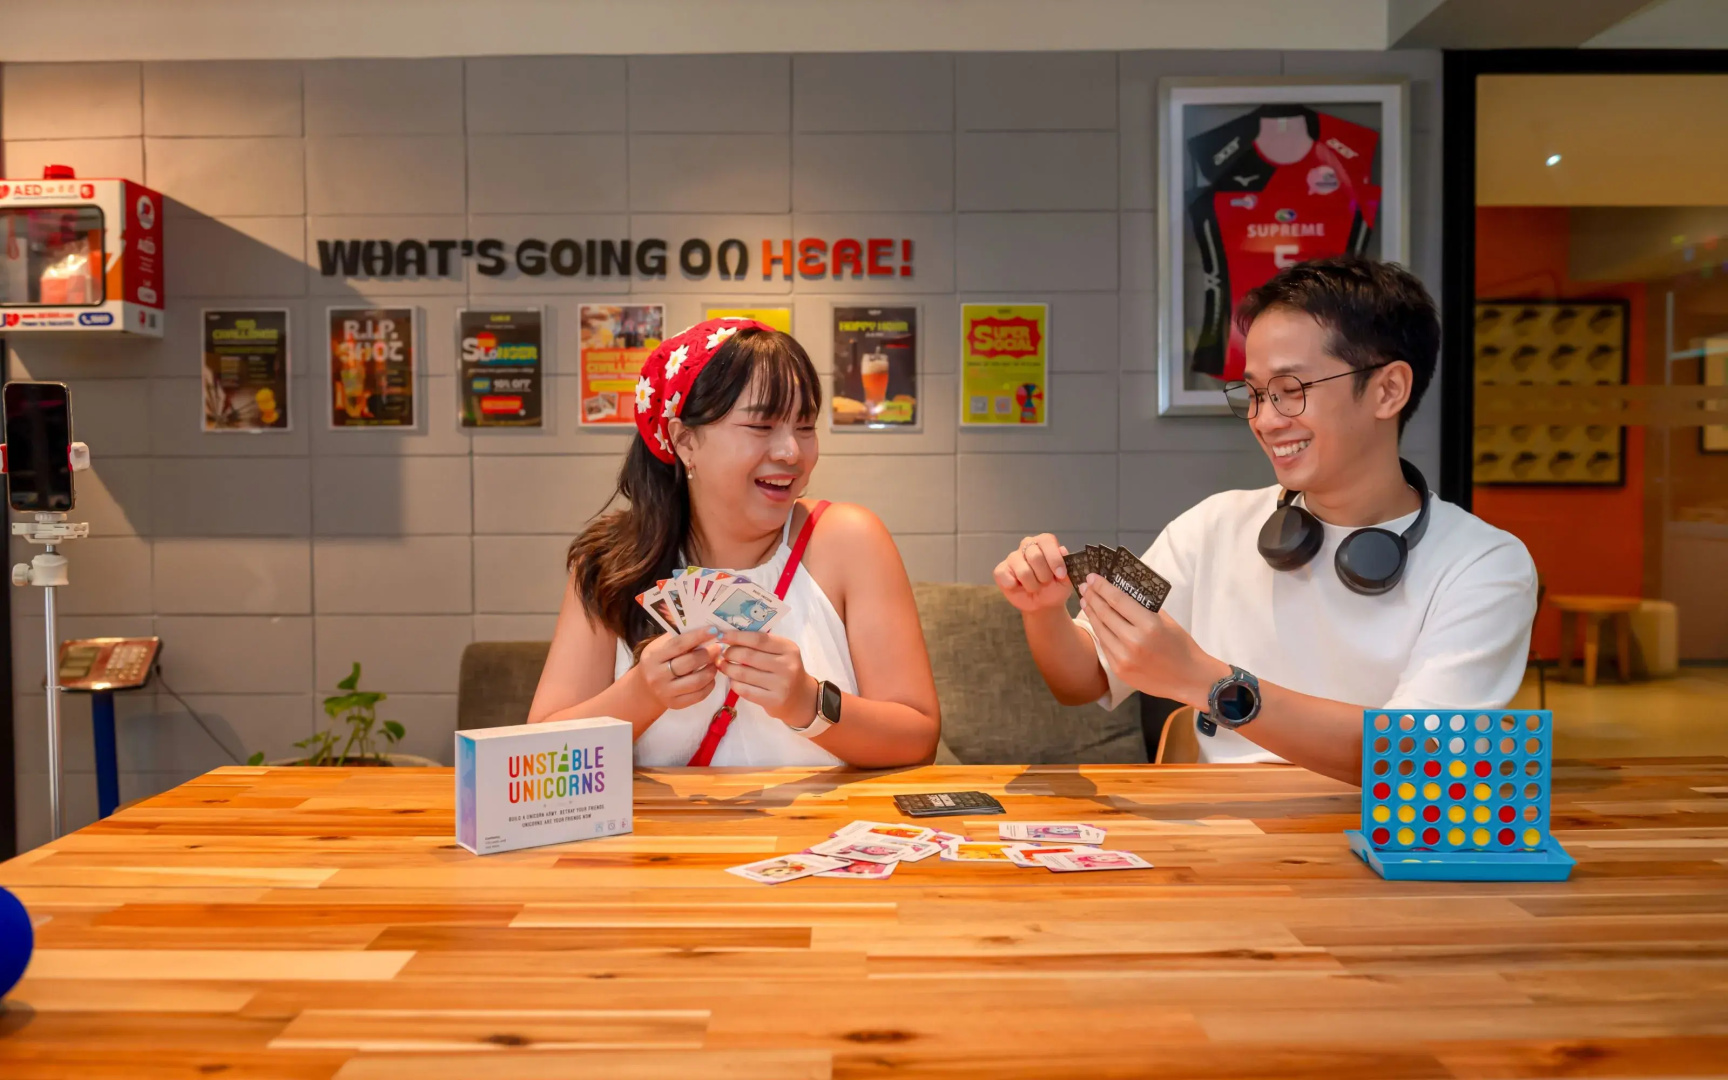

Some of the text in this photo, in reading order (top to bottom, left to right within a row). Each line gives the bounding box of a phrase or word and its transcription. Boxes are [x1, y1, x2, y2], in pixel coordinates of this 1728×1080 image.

[13, 184, 43, 196] AED
[1246, 222, 1325, 238] SUPREME
[316, 238, 506, 276] WHAT'S
[515, 238, 667, 276] GOING
[761, 238, 912, 276] HERE!
[343, 319, 399, 340] R.I.P.
[1114, 574, 1152, 608] UNSTABLE
[508, 742, 605, 778] UNSTABLE
[508, 771, 606, 804] UNICORNS
[526, 811, 545, 820] UNICORN
